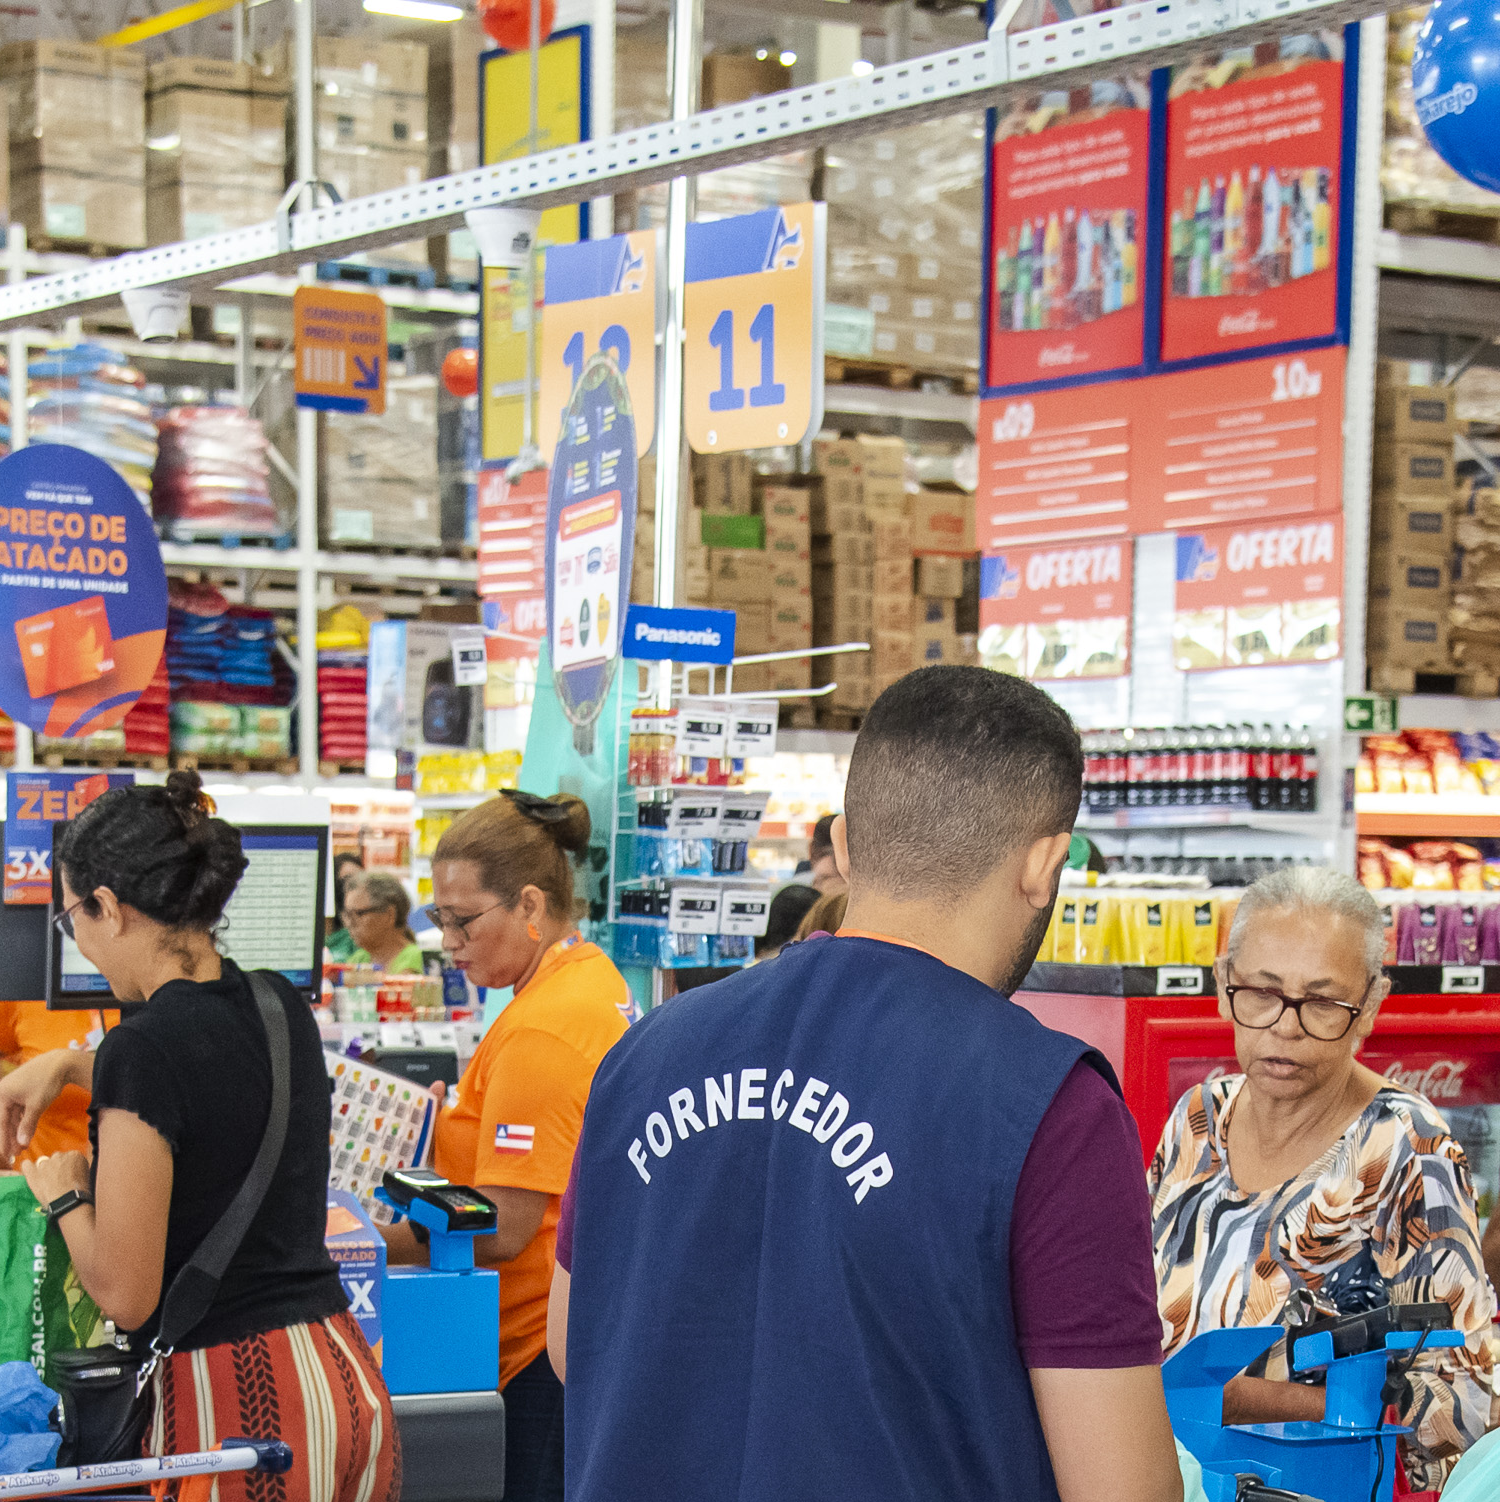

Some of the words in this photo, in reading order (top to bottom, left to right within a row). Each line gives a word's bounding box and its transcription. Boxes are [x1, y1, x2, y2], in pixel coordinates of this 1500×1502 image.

[708, 304, 786, 413] 11
[90, 514, 127, 543] DE
[1227, 524, 1334, 571] OFERTA
[1026, 546, 1120, 590] OFERTA
[3, 574, 40, 587] PARTIR
[42, 576, 56, 589] DE
[58, 577, 81, 590] UMA
[83, 579, 129, 594] UNIDADE
[636, 621, 722, 648] Panasonic
[7, 849, 51, 882] 3X
[627, 1067, 894, 1205] FORNECEDOR
[95, 1463, 143, 1478] Atakarejo
[174, 1453, 222, 1469] Atakarejo
[9, 1473, 59, 1489] Atakarejo
